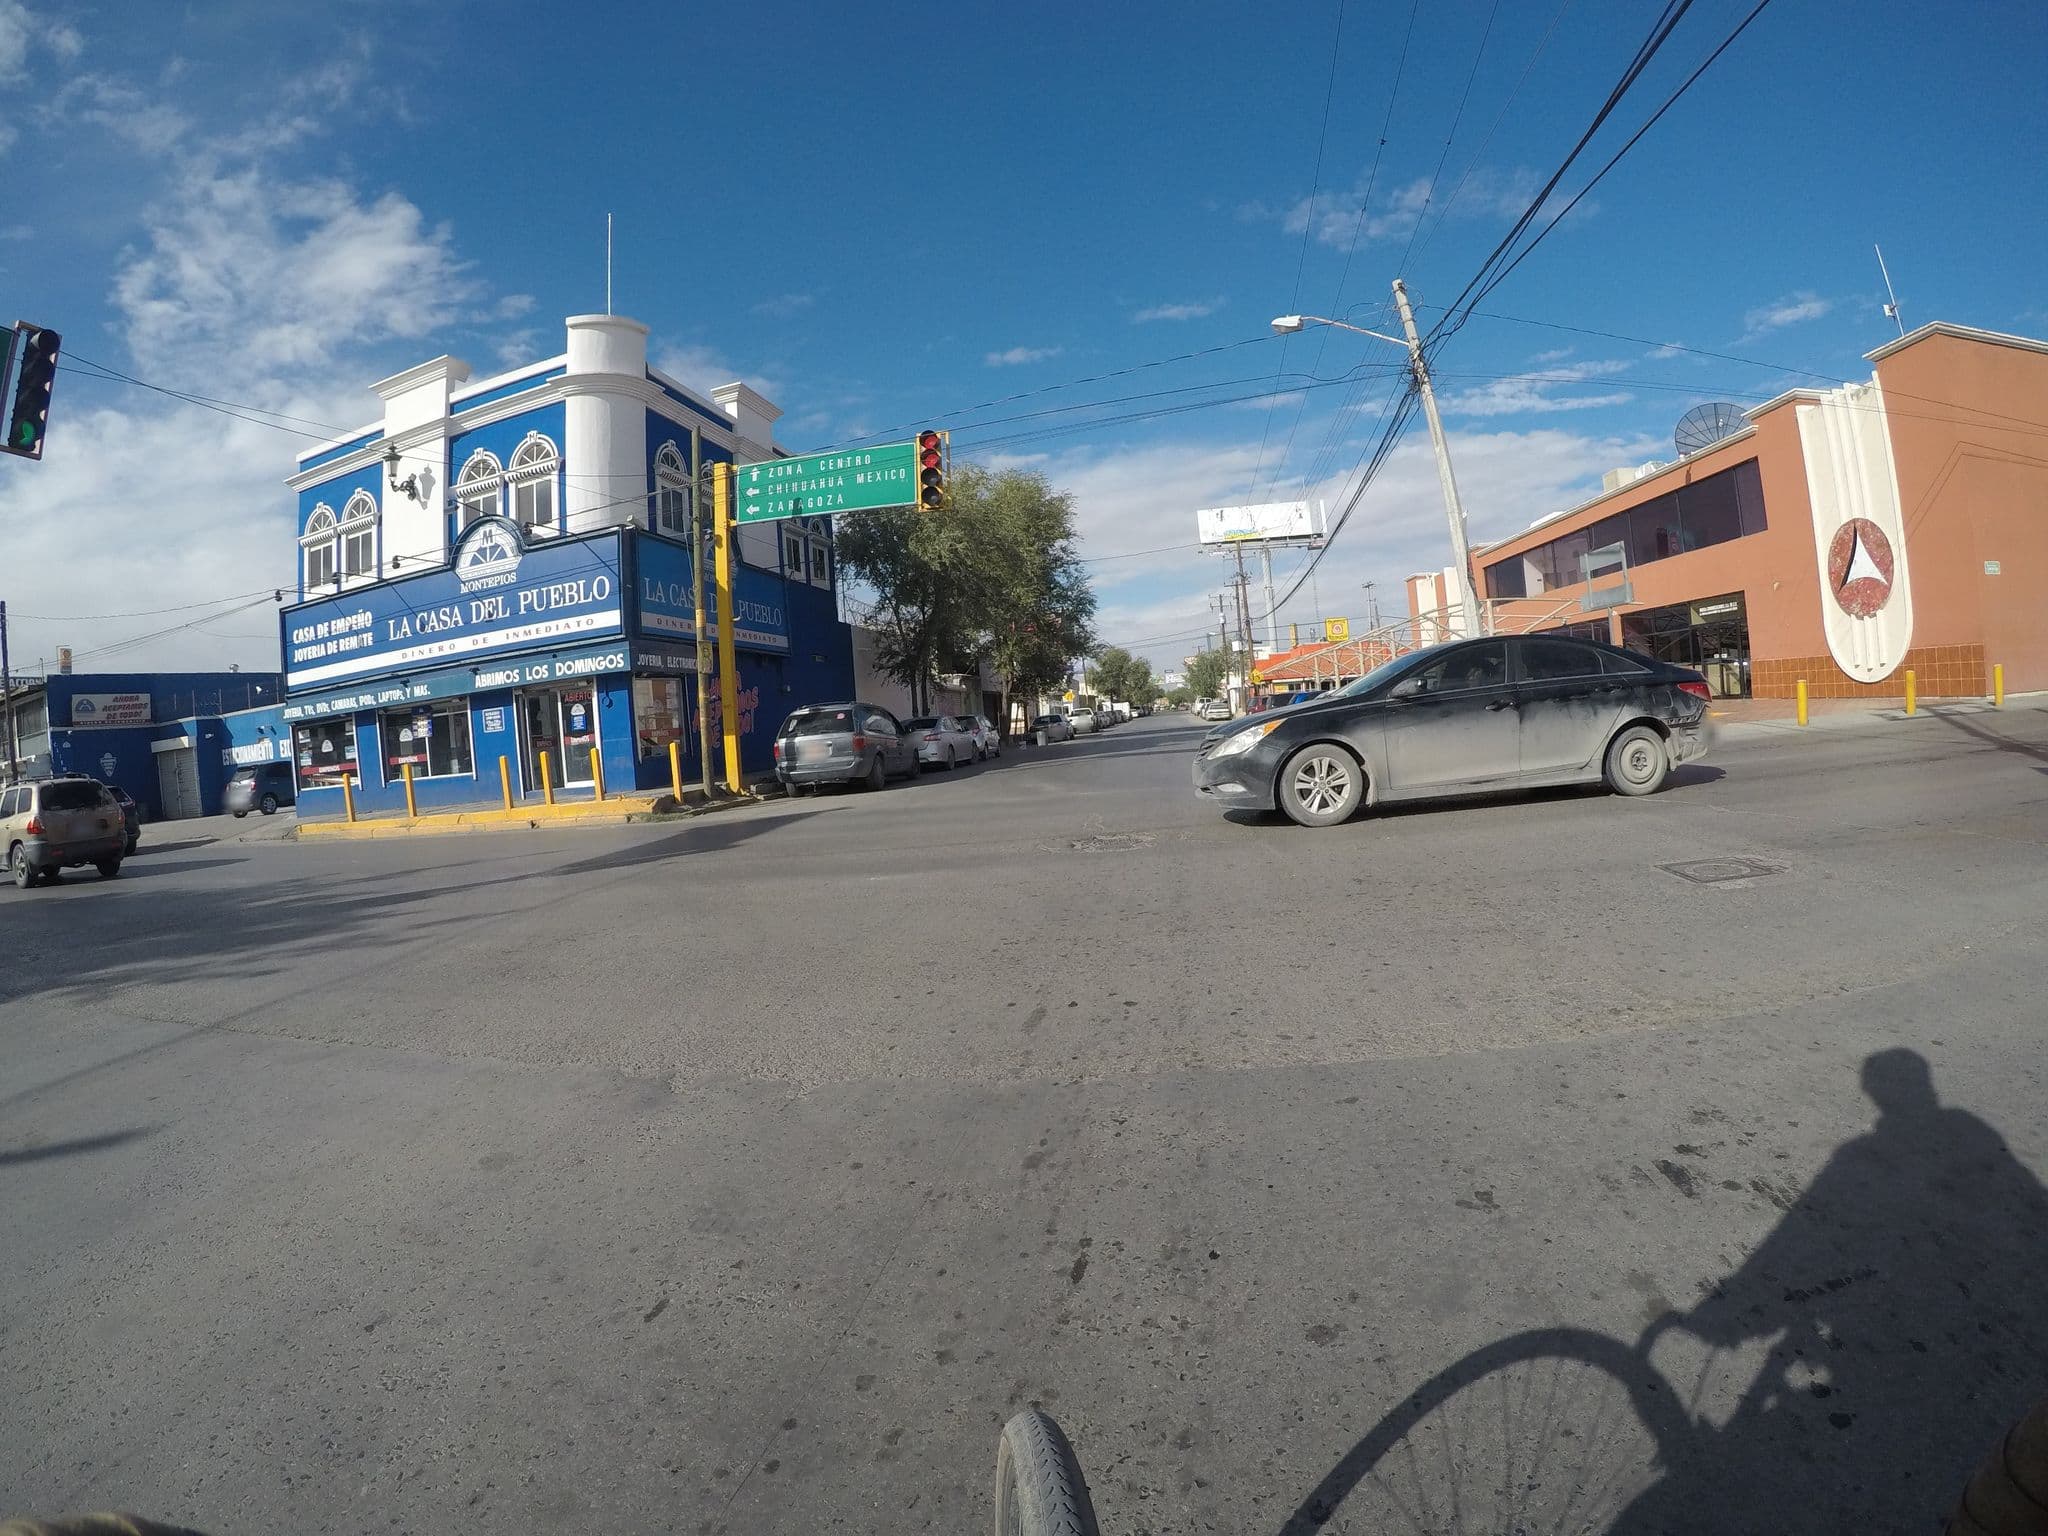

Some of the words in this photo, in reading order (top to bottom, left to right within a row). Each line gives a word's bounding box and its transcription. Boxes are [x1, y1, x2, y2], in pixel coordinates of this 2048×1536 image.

[768, 464, 803, 478] ZONA
[820, 454, 872, 471] CENTRO
[768, 475, 844, 495] CHIHUAHUA
[856, 468, 906, 484] MEXICO
[768, 493, 844, 513] ZARAGOZA
[460, 572, 517, 594] MONTEPIOS
[388, 616, 412, 640] LA
[416, 605, 464, 634] CASA
[471, 596, 510, 624] DEL
[518, 575, 610, 615] PUEBLO
[644, 577, 666, 603] LA
[669, 583, 694, 609] CAS
[739, 599, 782, 627] PUEBLO
[293, 626, 315, 644] CASA
[317, 621, 330, 639] DE
[331, 609, 373, 635] EMPEÑO
[401, 642, 456, 660] DINERO
[472, 637, 489, 646] DE
[505, 618, 595, 641] INMEDIATO
[656, 617, 693, 631] DINER
[736, 631, 777, 644] NMEDIATO
[294, 641, 326, 662] JOYERIA
[327, 639, 338, 655] DE
[339, 632, 374, 652] REMATE
[475, 669, 520, 689] ABRIMOS
[526, 664, 549, 681] LOS
[555, 653, 625, 677] DOMINGOS
[565, 690, 593, 702] ABIERTO
